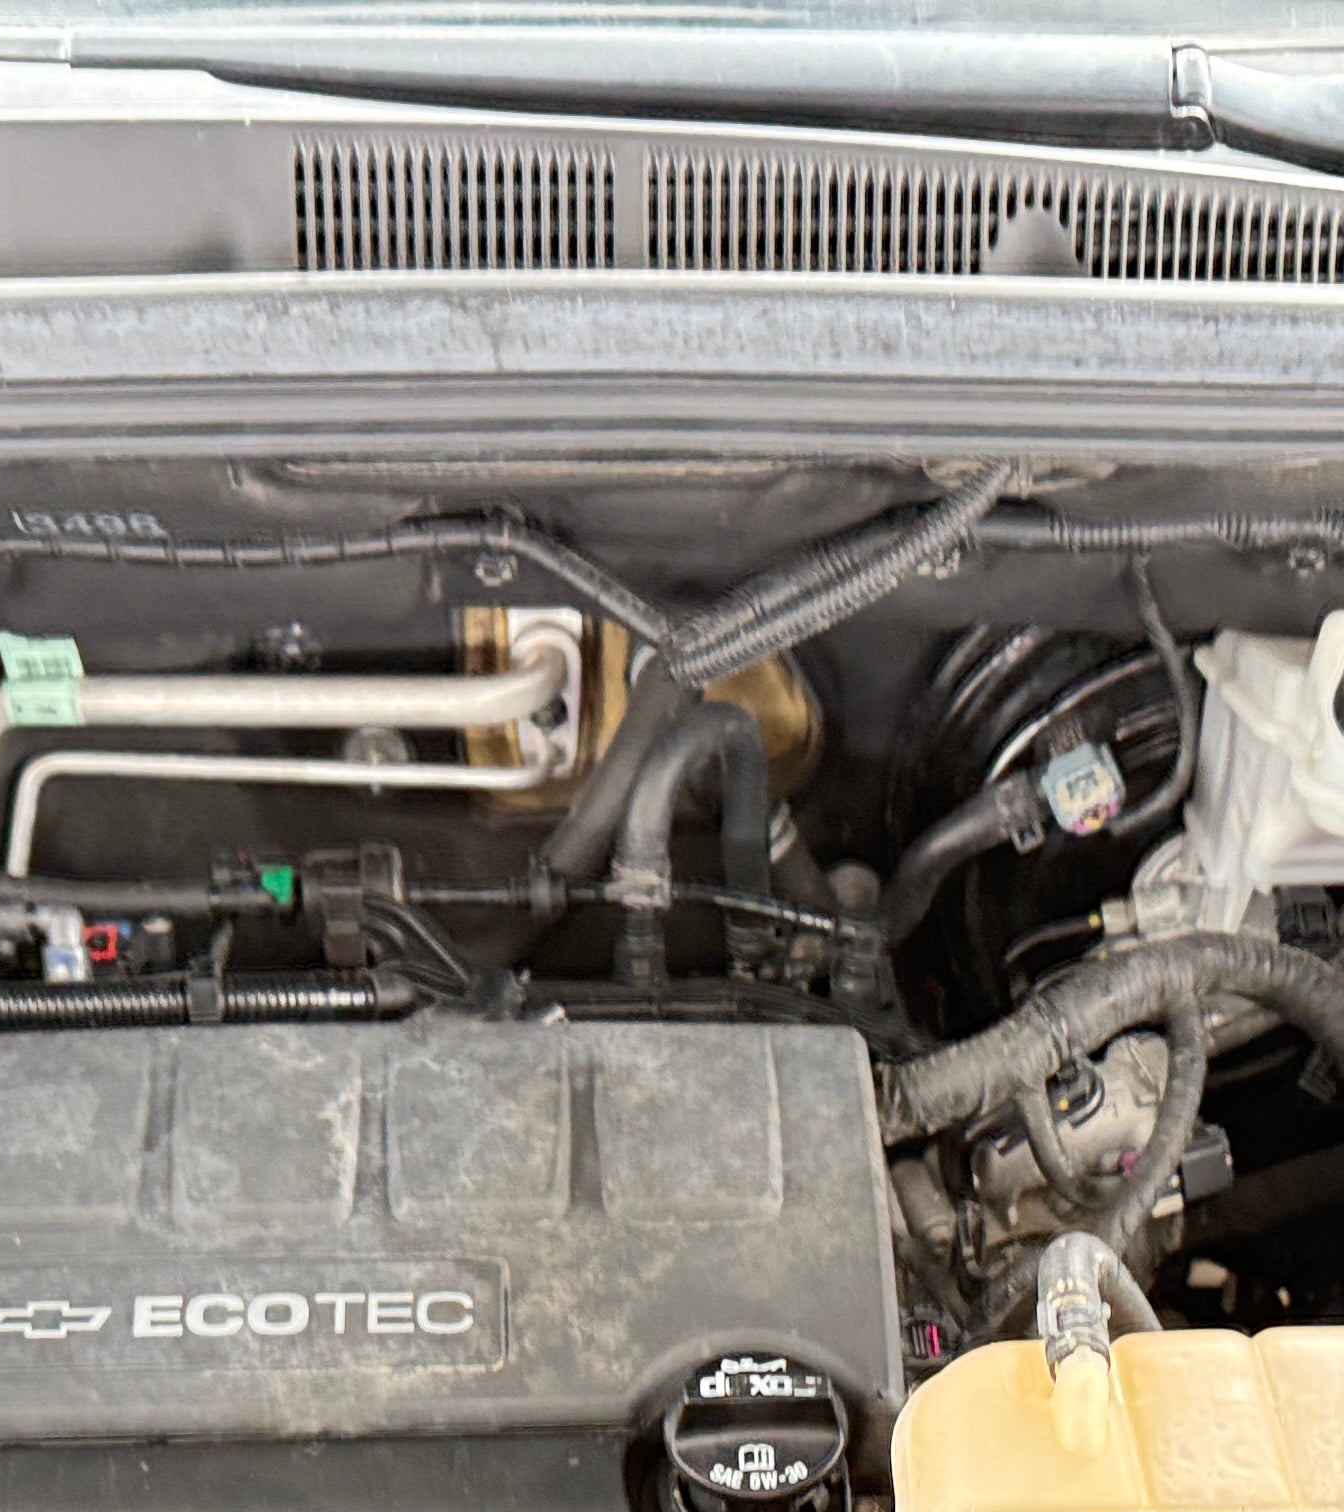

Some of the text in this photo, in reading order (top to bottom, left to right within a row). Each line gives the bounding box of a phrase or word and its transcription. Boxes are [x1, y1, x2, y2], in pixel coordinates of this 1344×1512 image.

[132, 1291, 475, 1338] ECOTEC
[709, 1460, 808, 1491] SAE 5W-30
